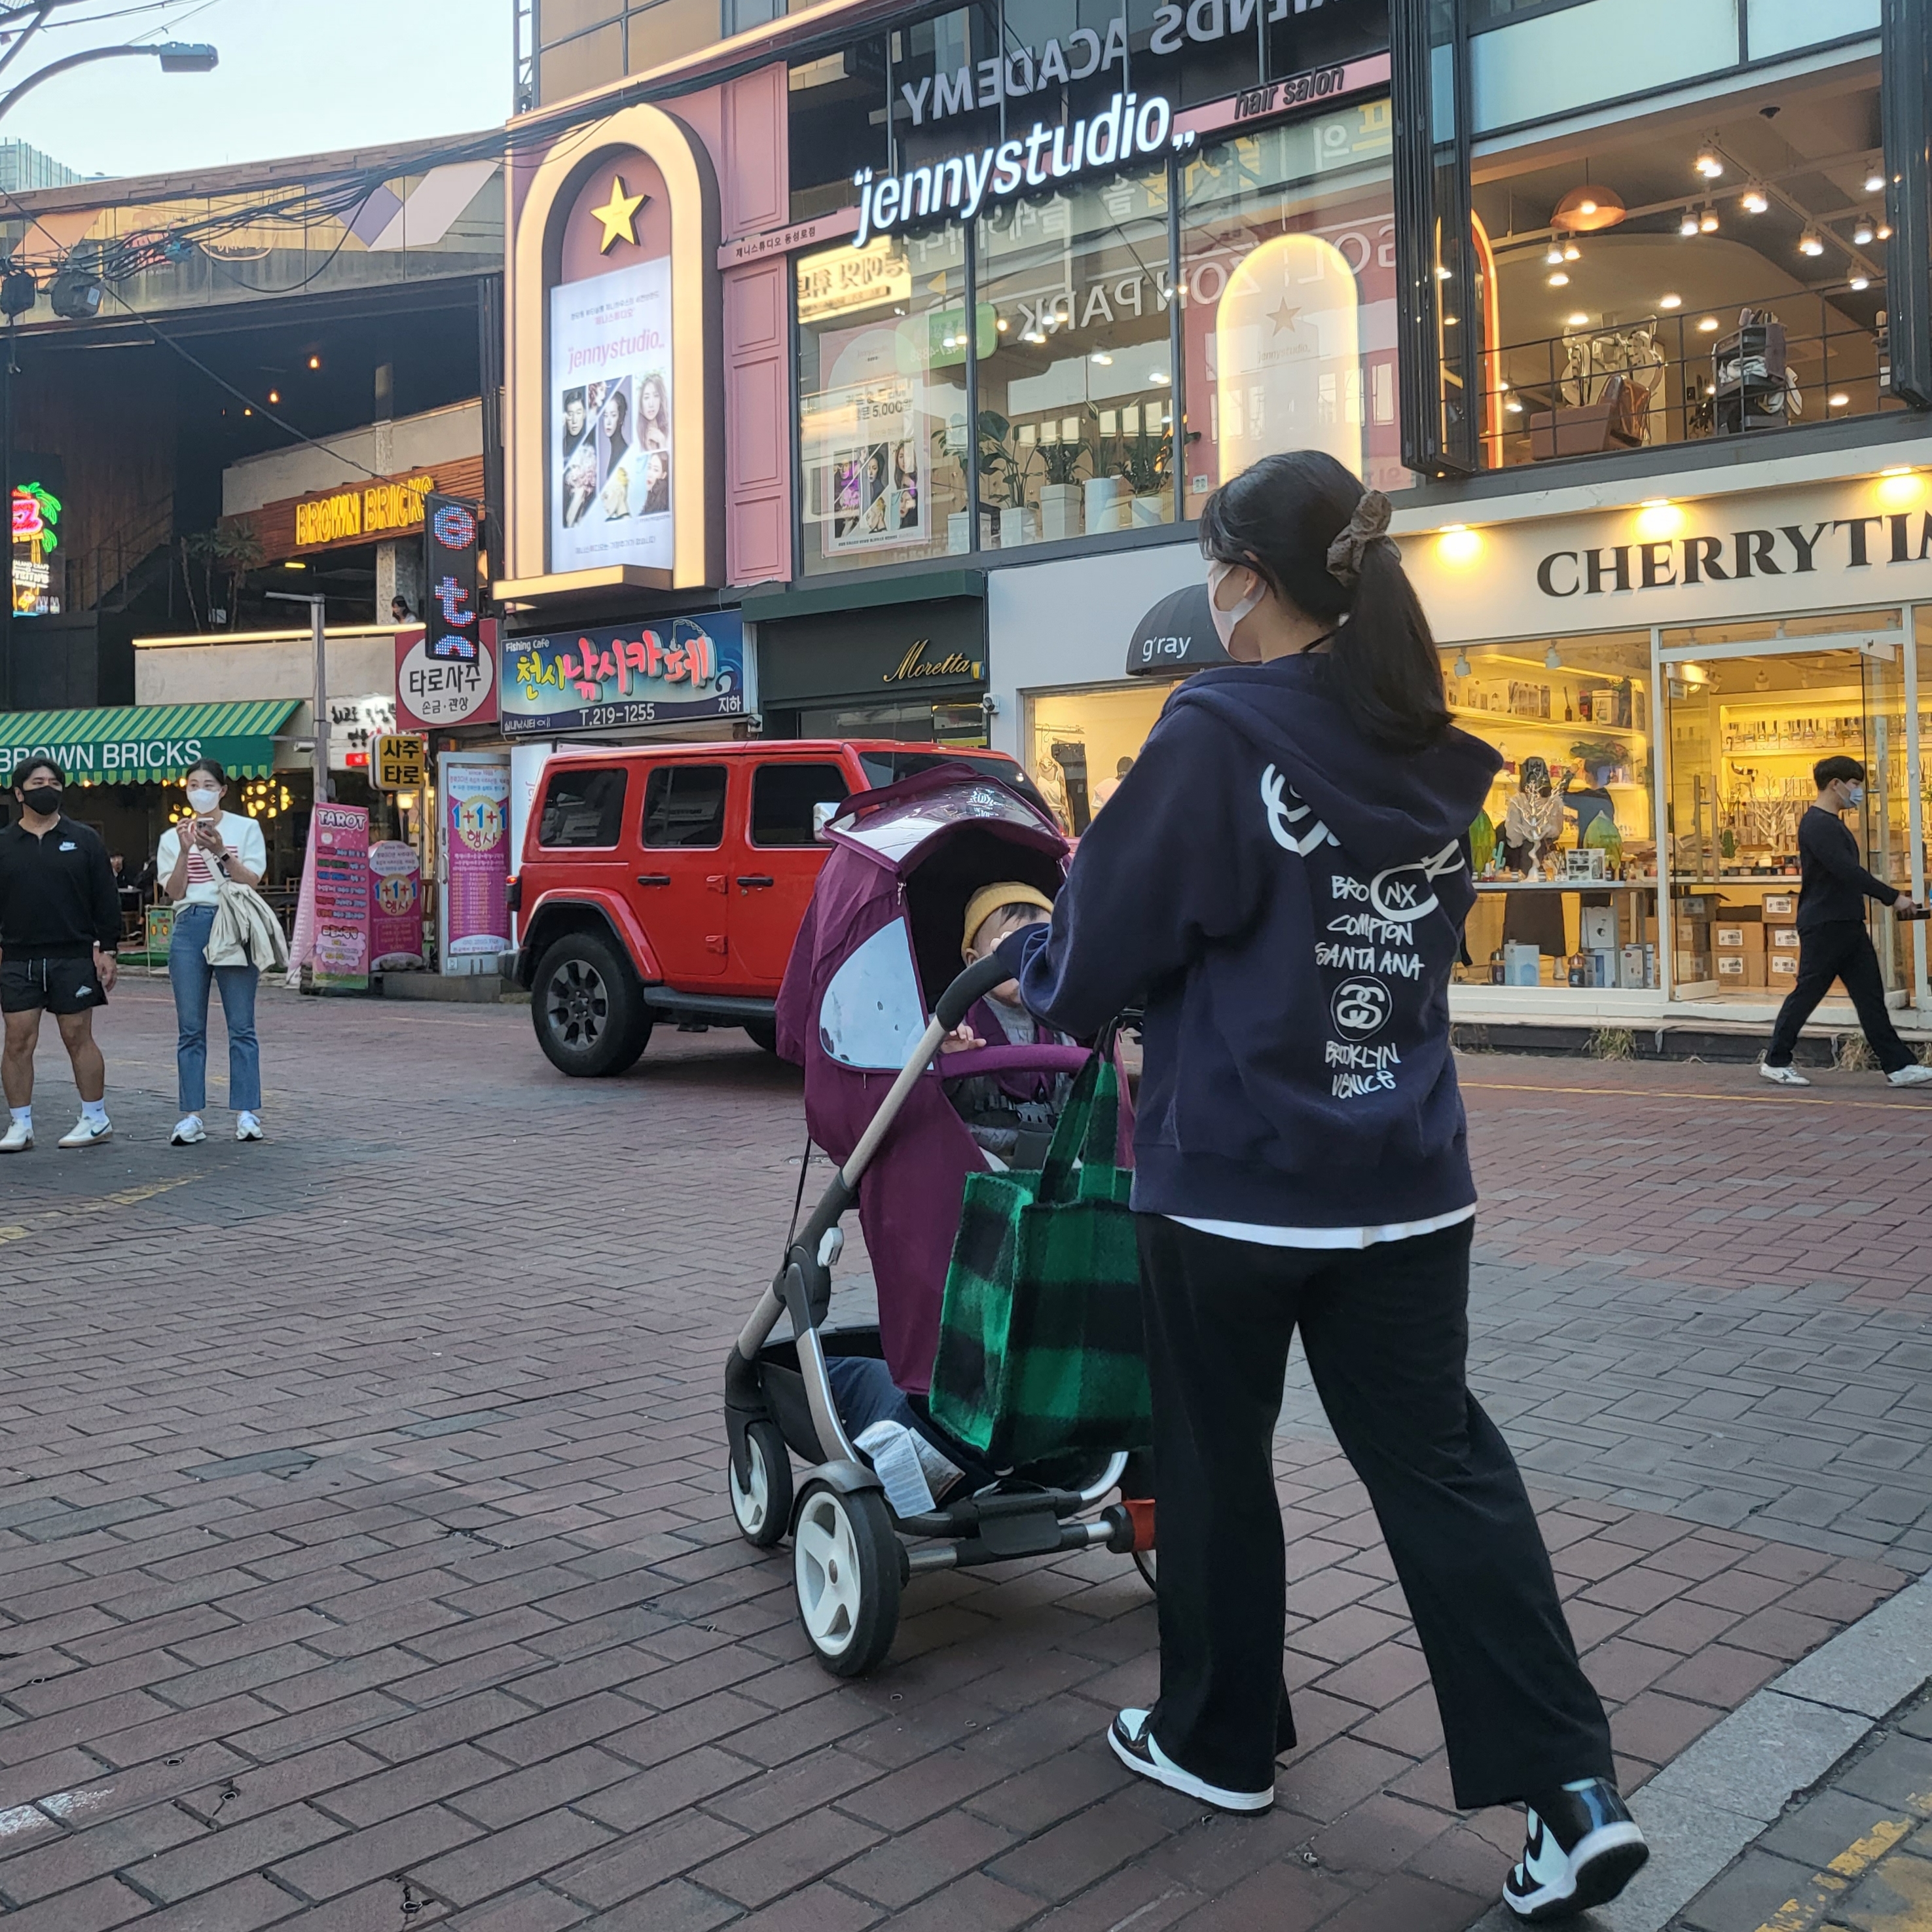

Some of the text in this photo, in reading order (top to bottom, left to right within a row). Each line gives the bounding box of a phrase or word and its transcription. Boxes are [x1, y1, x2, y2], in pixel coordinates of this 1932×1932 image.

[1234, 67, 1345, 120] hair salon
[296, 492, 360, 545] BROWN
[1537, 510, 1932, 598] CHERRYTI
[505, 641, 531, 653] Fishing
[883, 638, 971, 682] Moretta
[409, 664, 482, 697] 타로사주
[718, 695, 741, 714] 지하
[103, 739, 202, 769] BRICKS
[383, 740, 420, 759] 사주
[384, 765, 420, 784] 타로
[318, 809, 366, 831] TAROT
[452, 803, 507, 829] 1+1+1
[467, 829, 498, 848] 행사
[386, 900, 409, 914] 행사
[1326, 913, 1414, 946] COMPTON
[1315, 942, 1426, 981] SANTA ANA
[1332, 1070, 1397, 1099] VENICE
